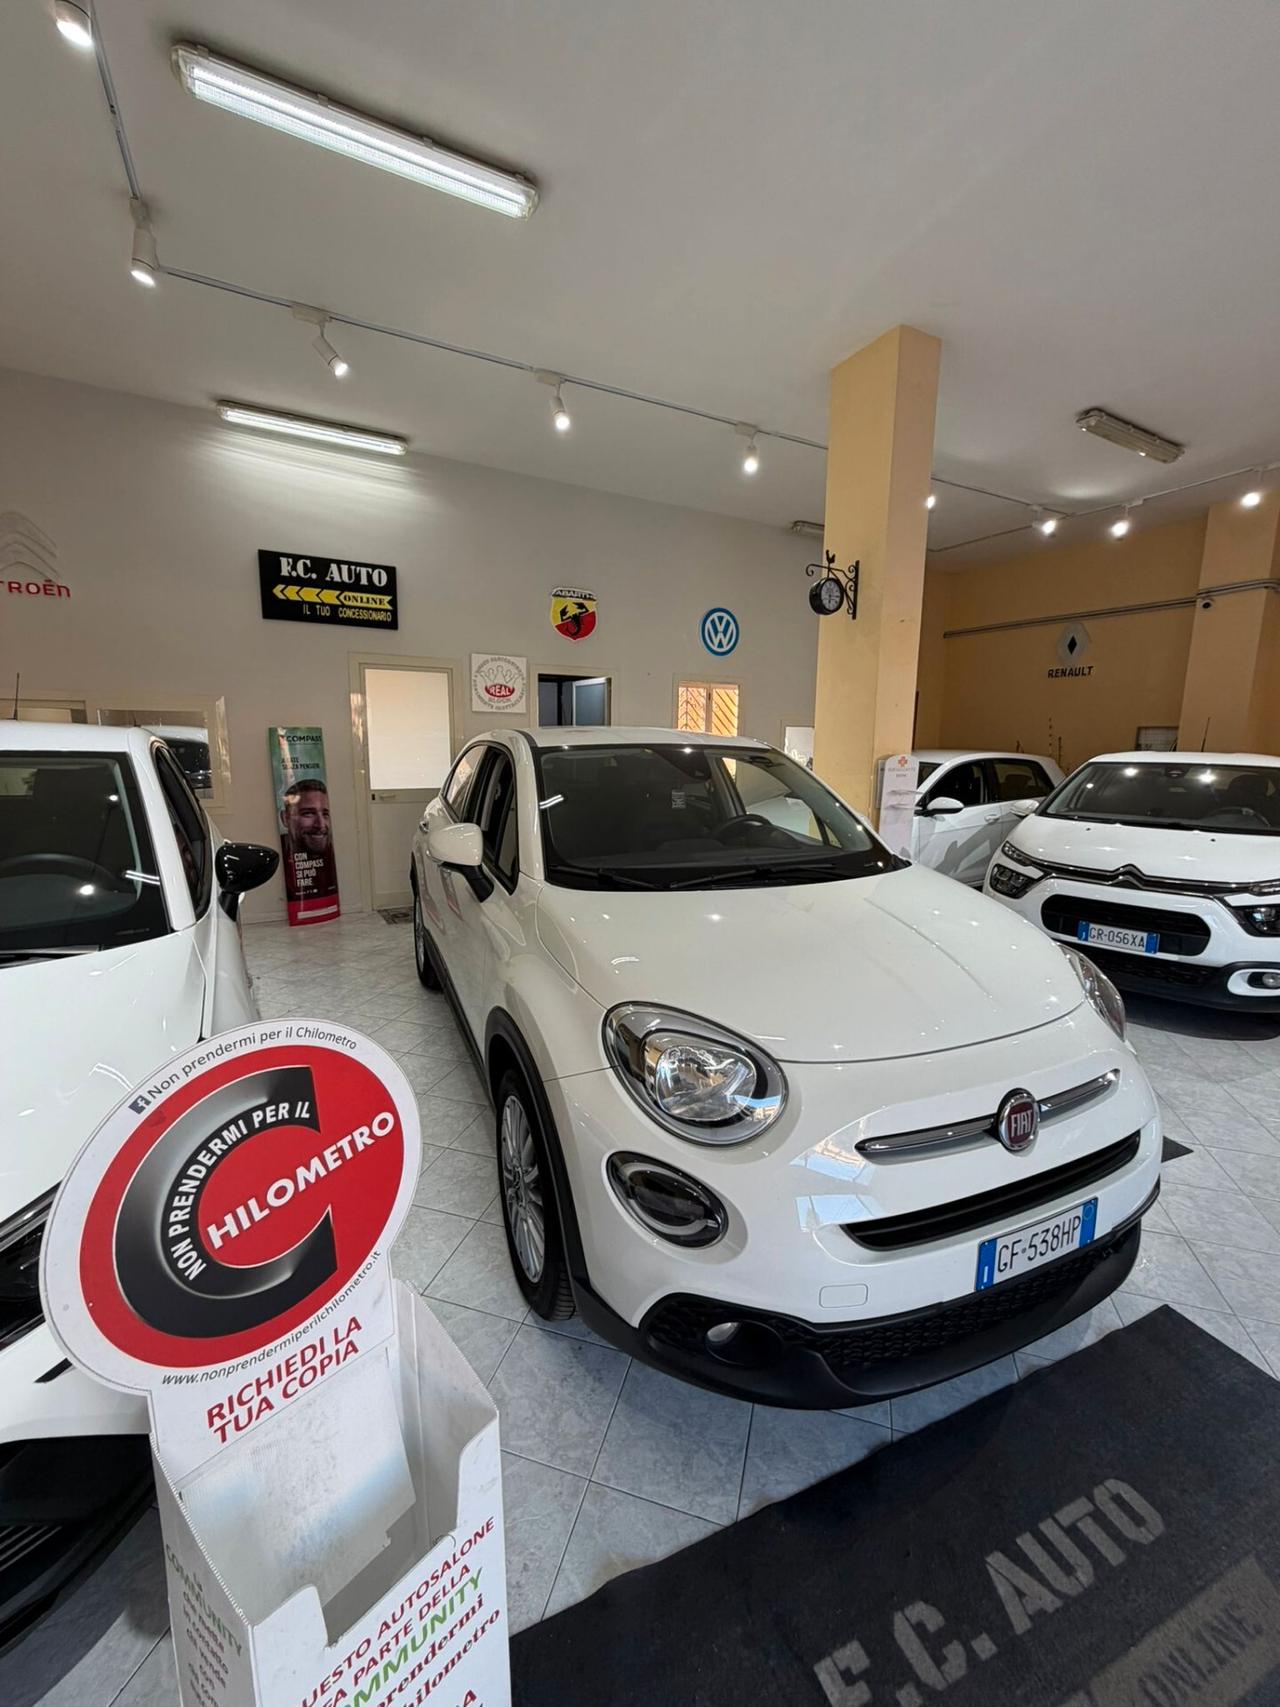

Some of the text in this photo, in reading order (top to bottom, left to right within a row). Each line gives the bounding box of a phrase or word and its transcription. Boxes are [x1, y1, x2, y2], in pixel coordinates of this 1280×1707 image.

[280, 557, 388, 587] F.C. AUTO
[303, 604, 392, 622] IL TUO CONCESSIONARIO
[343, 594, 386, 607] ONLINE
[489, 685, 512, 697] REAL
[1047, 665, 1094, 679] RENAULT
[295, 859, 324, 870] COMPASS
[147, 1073, 180, 1100] Non
[181, 1032, 256, 1078] prendermi
[259, 1028, 283, 1045] per
[285, 1026, 294, 1039] il
[295, 1026, 358, 1051] Chilometro
[1010, 1109, 1033, 1138] FIAT
[168, 1101, 312, 1281] NON PRENDERMI PER IL
[161, 1250, 382, 1386] www.nonprendermiperilchilometro.it
[206, 1316, 363, 1430] RICHIEDI LA
[213, 1340, 360, 1444] TUA COPIA
[985, 1478, 1165, 1636] AUTO
[301, 1638, 372, 1707] UESTO
[377, 1516, 495, 1641] AUTOSALONE
[345, 1566, 483, 1707] MMUNITY
[353, 1618, 414, 1687] PARTE
[418, 1564, 471, 1621] DELLA
